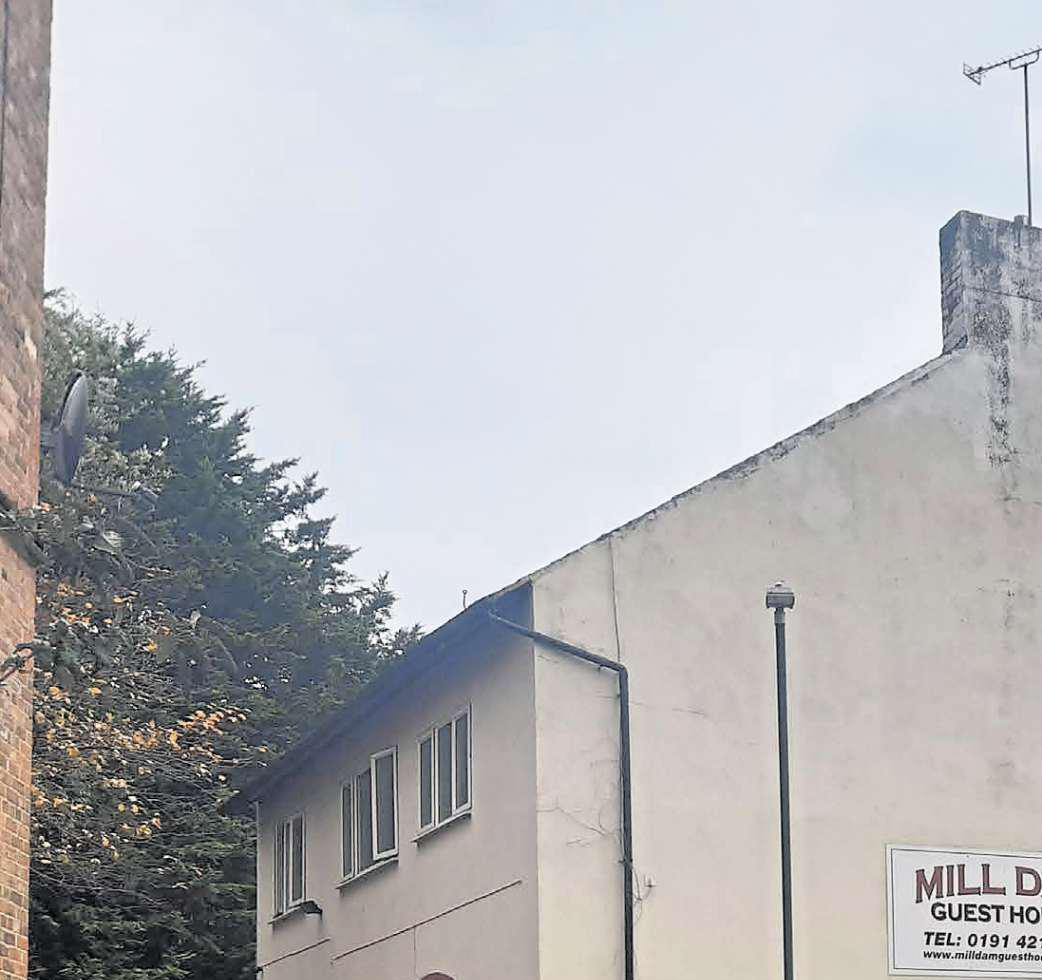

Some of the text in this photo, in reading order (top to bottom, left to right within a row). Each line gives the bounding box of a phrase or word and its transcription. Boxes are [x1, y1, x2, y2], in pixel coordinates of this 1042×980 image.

[915, 863, 1006, 904] MILL
[930, 902, 1005, 923] GUEST
[924, 931, 961, 947] TEL:
[967, 933, 1010, 948] 0191
